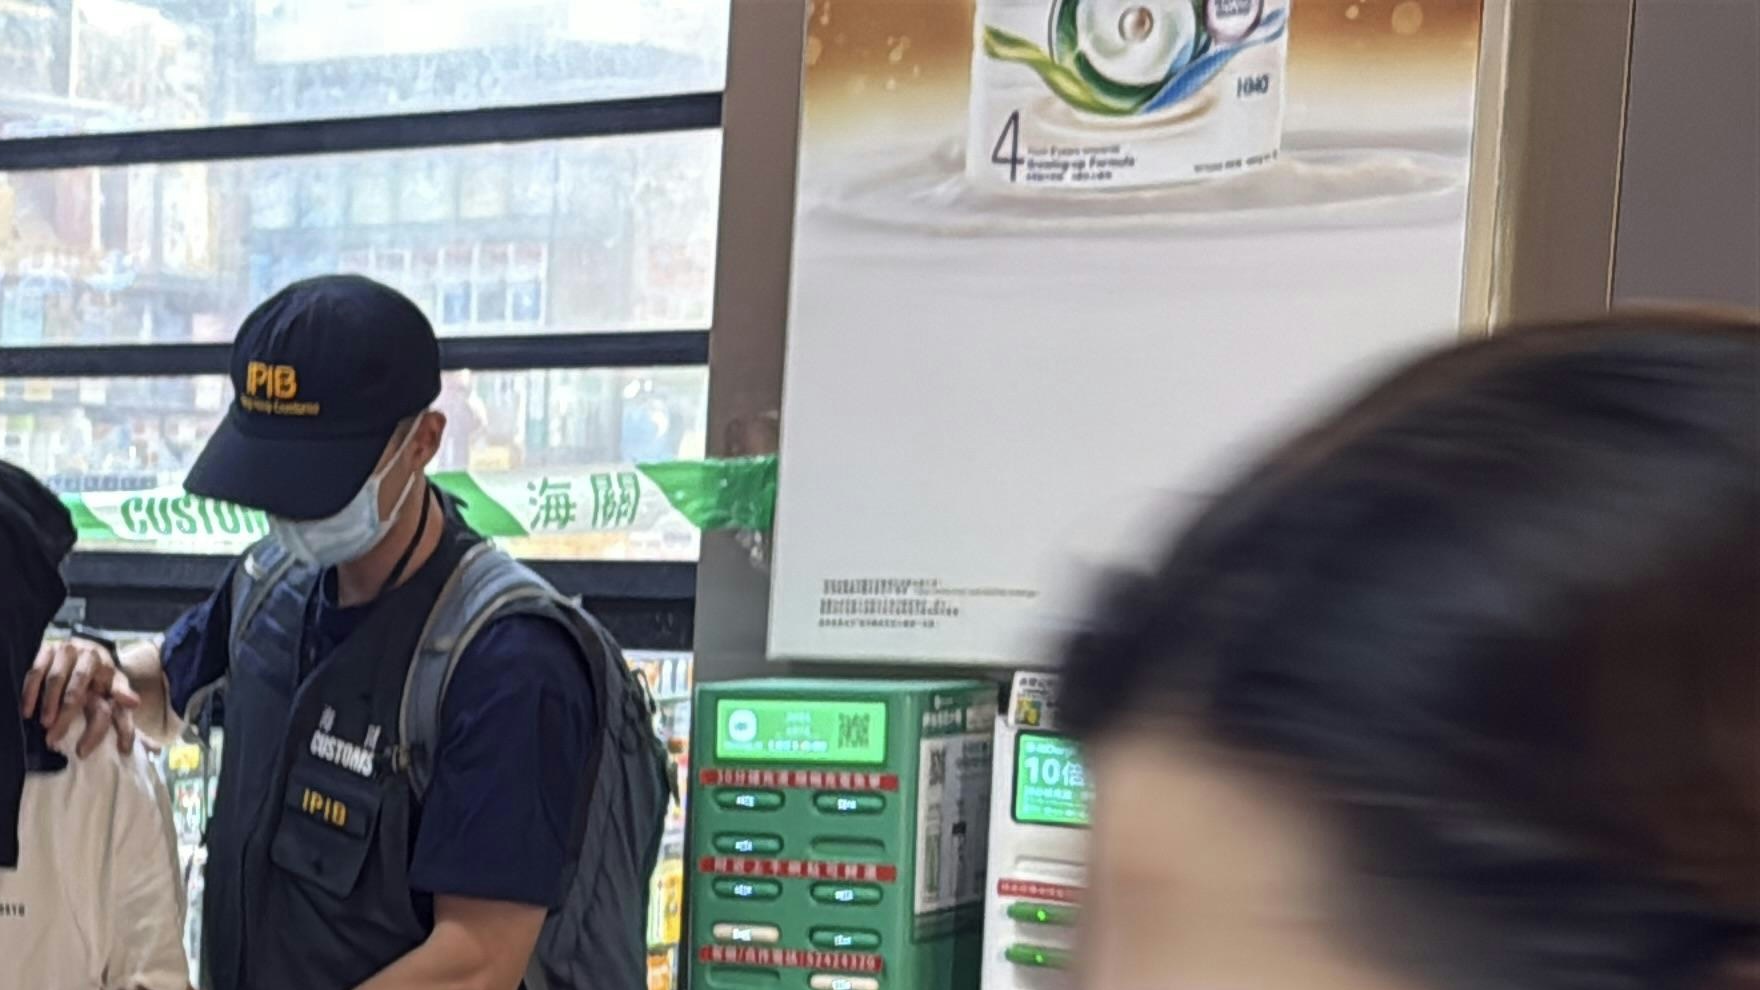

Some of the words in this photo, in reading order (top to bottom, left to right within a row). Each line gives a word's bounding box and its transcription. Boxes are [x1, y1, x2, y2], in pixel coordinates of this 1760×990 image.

[991, 109, 1025, 183] 4
[246, 360, 298, 400] IPIB
[527, 472, 640, 530] 海關
[309, 729, 375, 778] CUSTOMS
[301, 786, 348, 827] IPIB
